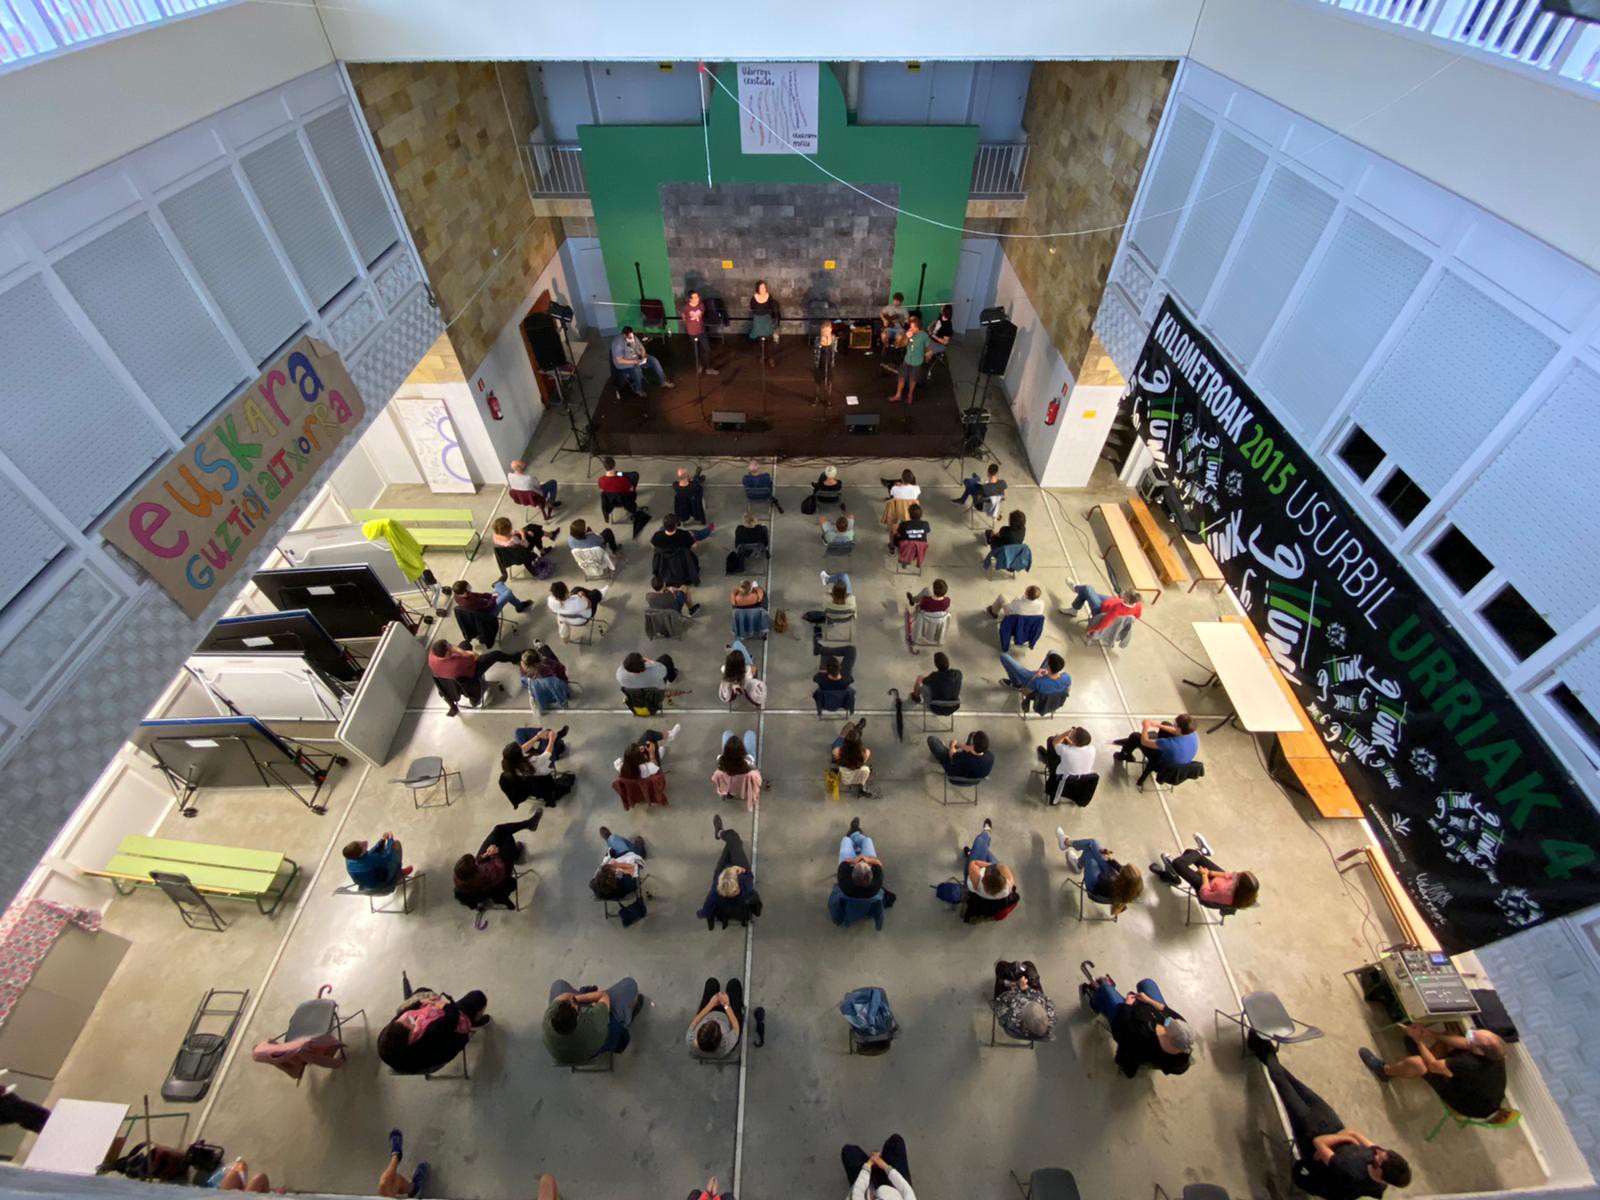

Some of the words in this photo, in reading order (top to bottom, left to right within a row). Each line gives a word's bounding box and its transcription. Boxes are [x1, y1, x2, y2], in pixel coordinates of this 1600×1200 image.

[1154, 312, 1254, 444] KILOMETROAK
[1239, 424, 1297, 495] 2015
[1286, 480, 1396, 630] USURBIL
[1388, 614, 1562, 831] URRIAK
[1539, 838, 1597, 880] 4
